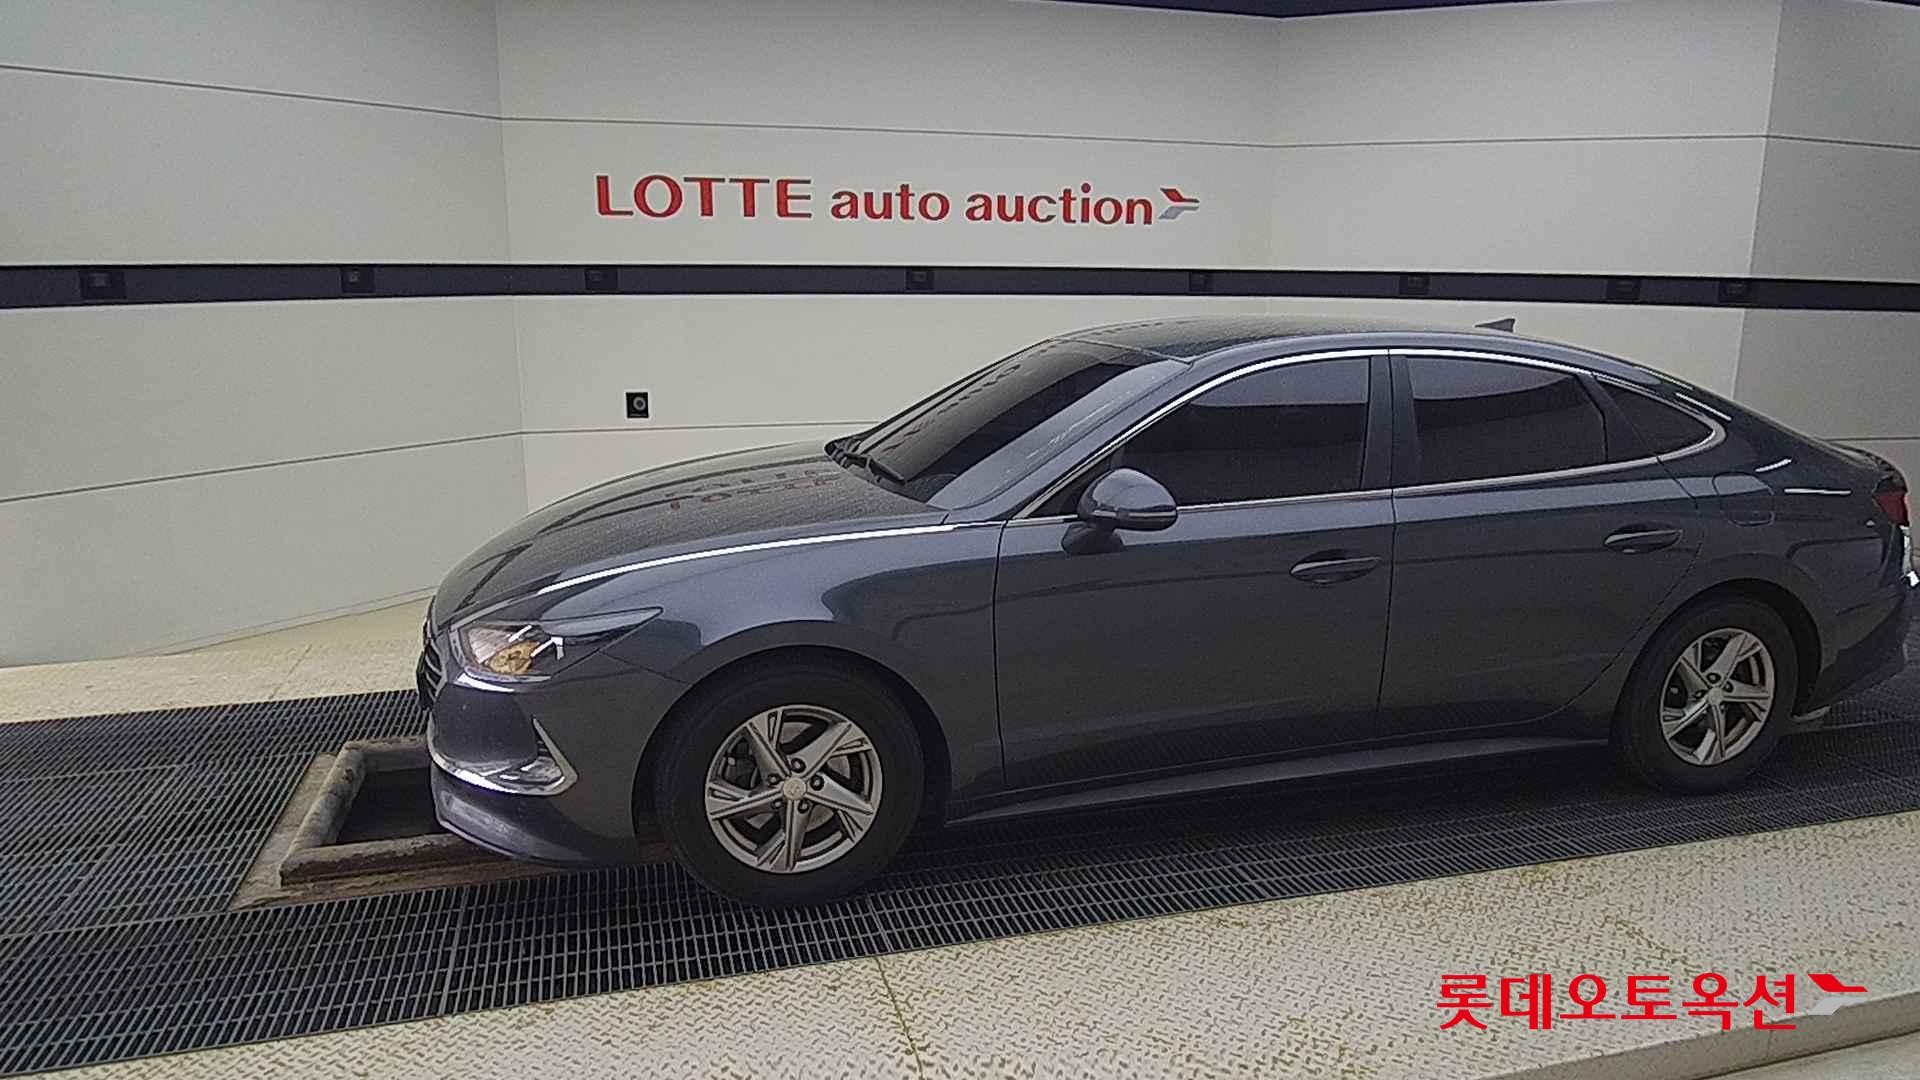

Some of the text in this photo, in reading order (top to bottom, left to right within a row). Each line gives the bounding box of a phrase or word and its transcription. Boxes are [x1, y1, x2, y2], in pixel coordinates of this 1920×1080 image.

[597, 175, 1153, 225] LOTTE auto auction
